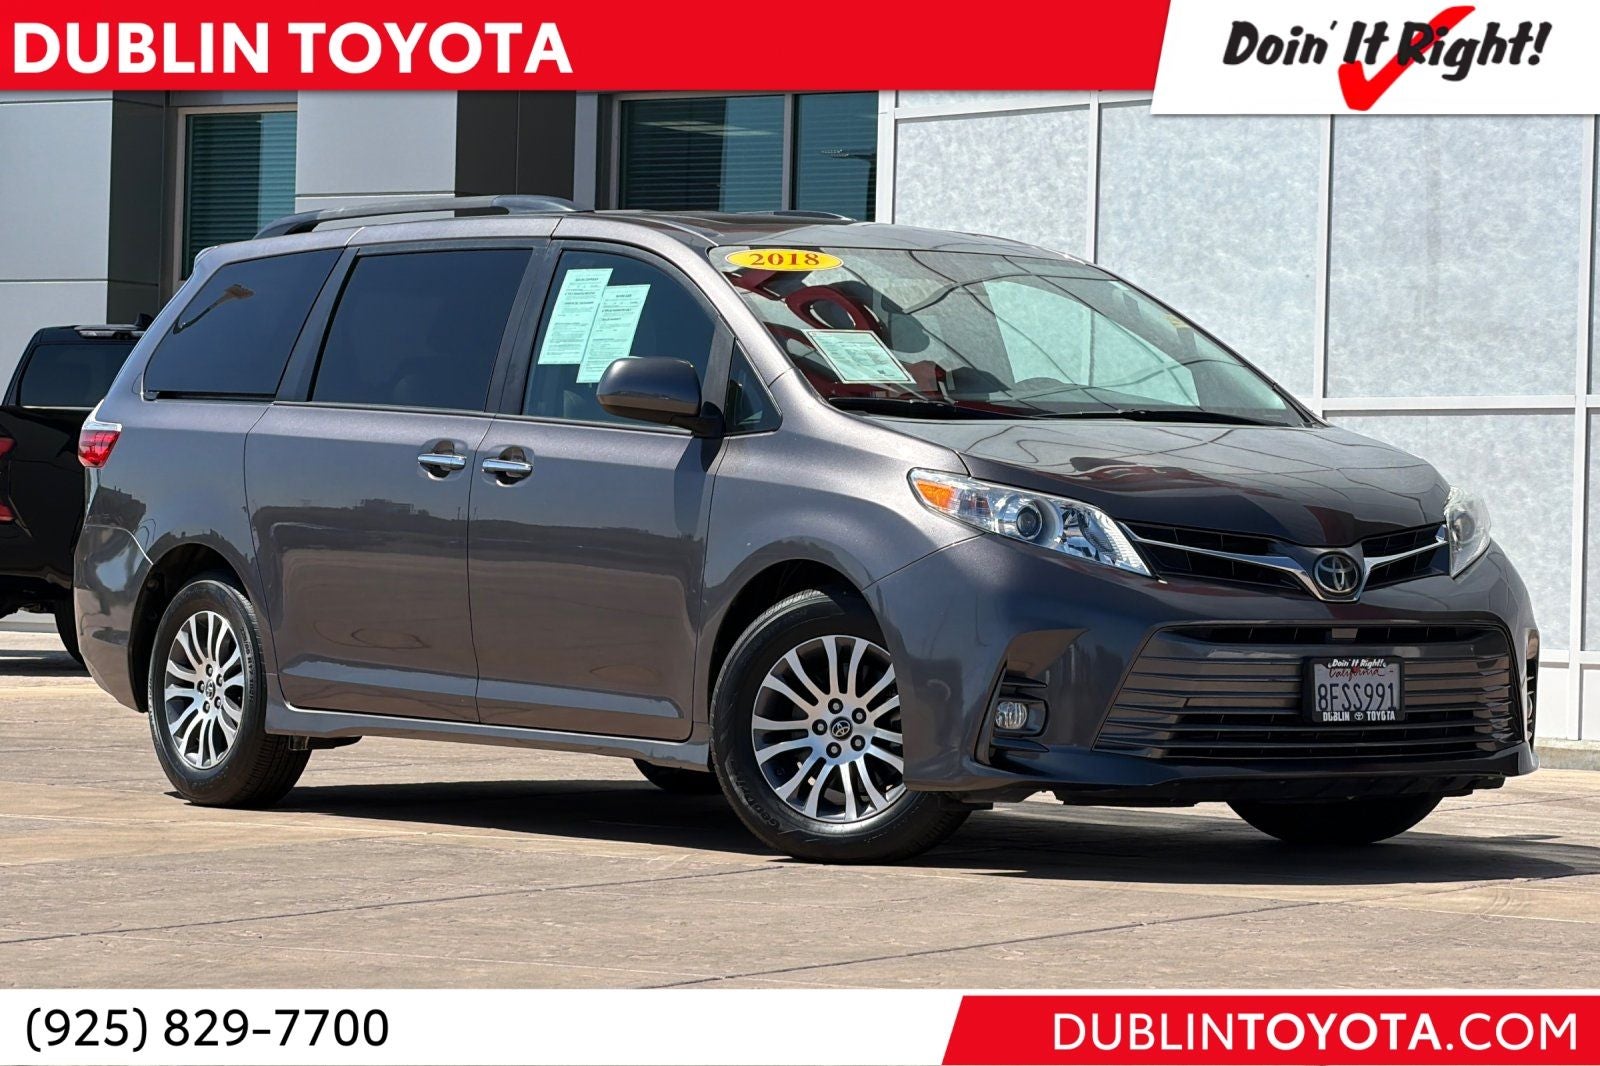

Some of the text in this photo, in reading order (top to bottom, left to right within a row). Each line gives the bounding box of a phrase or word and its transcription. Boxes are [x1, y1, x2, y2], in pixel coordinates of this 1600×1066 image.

[748, 252, 820, 266] 2018
[1351, 658, 1360, 668] It
[1360, 658, 1384, 670] Right!
[1322, 711, 1395, 722] DUBLIN TOYOTA
